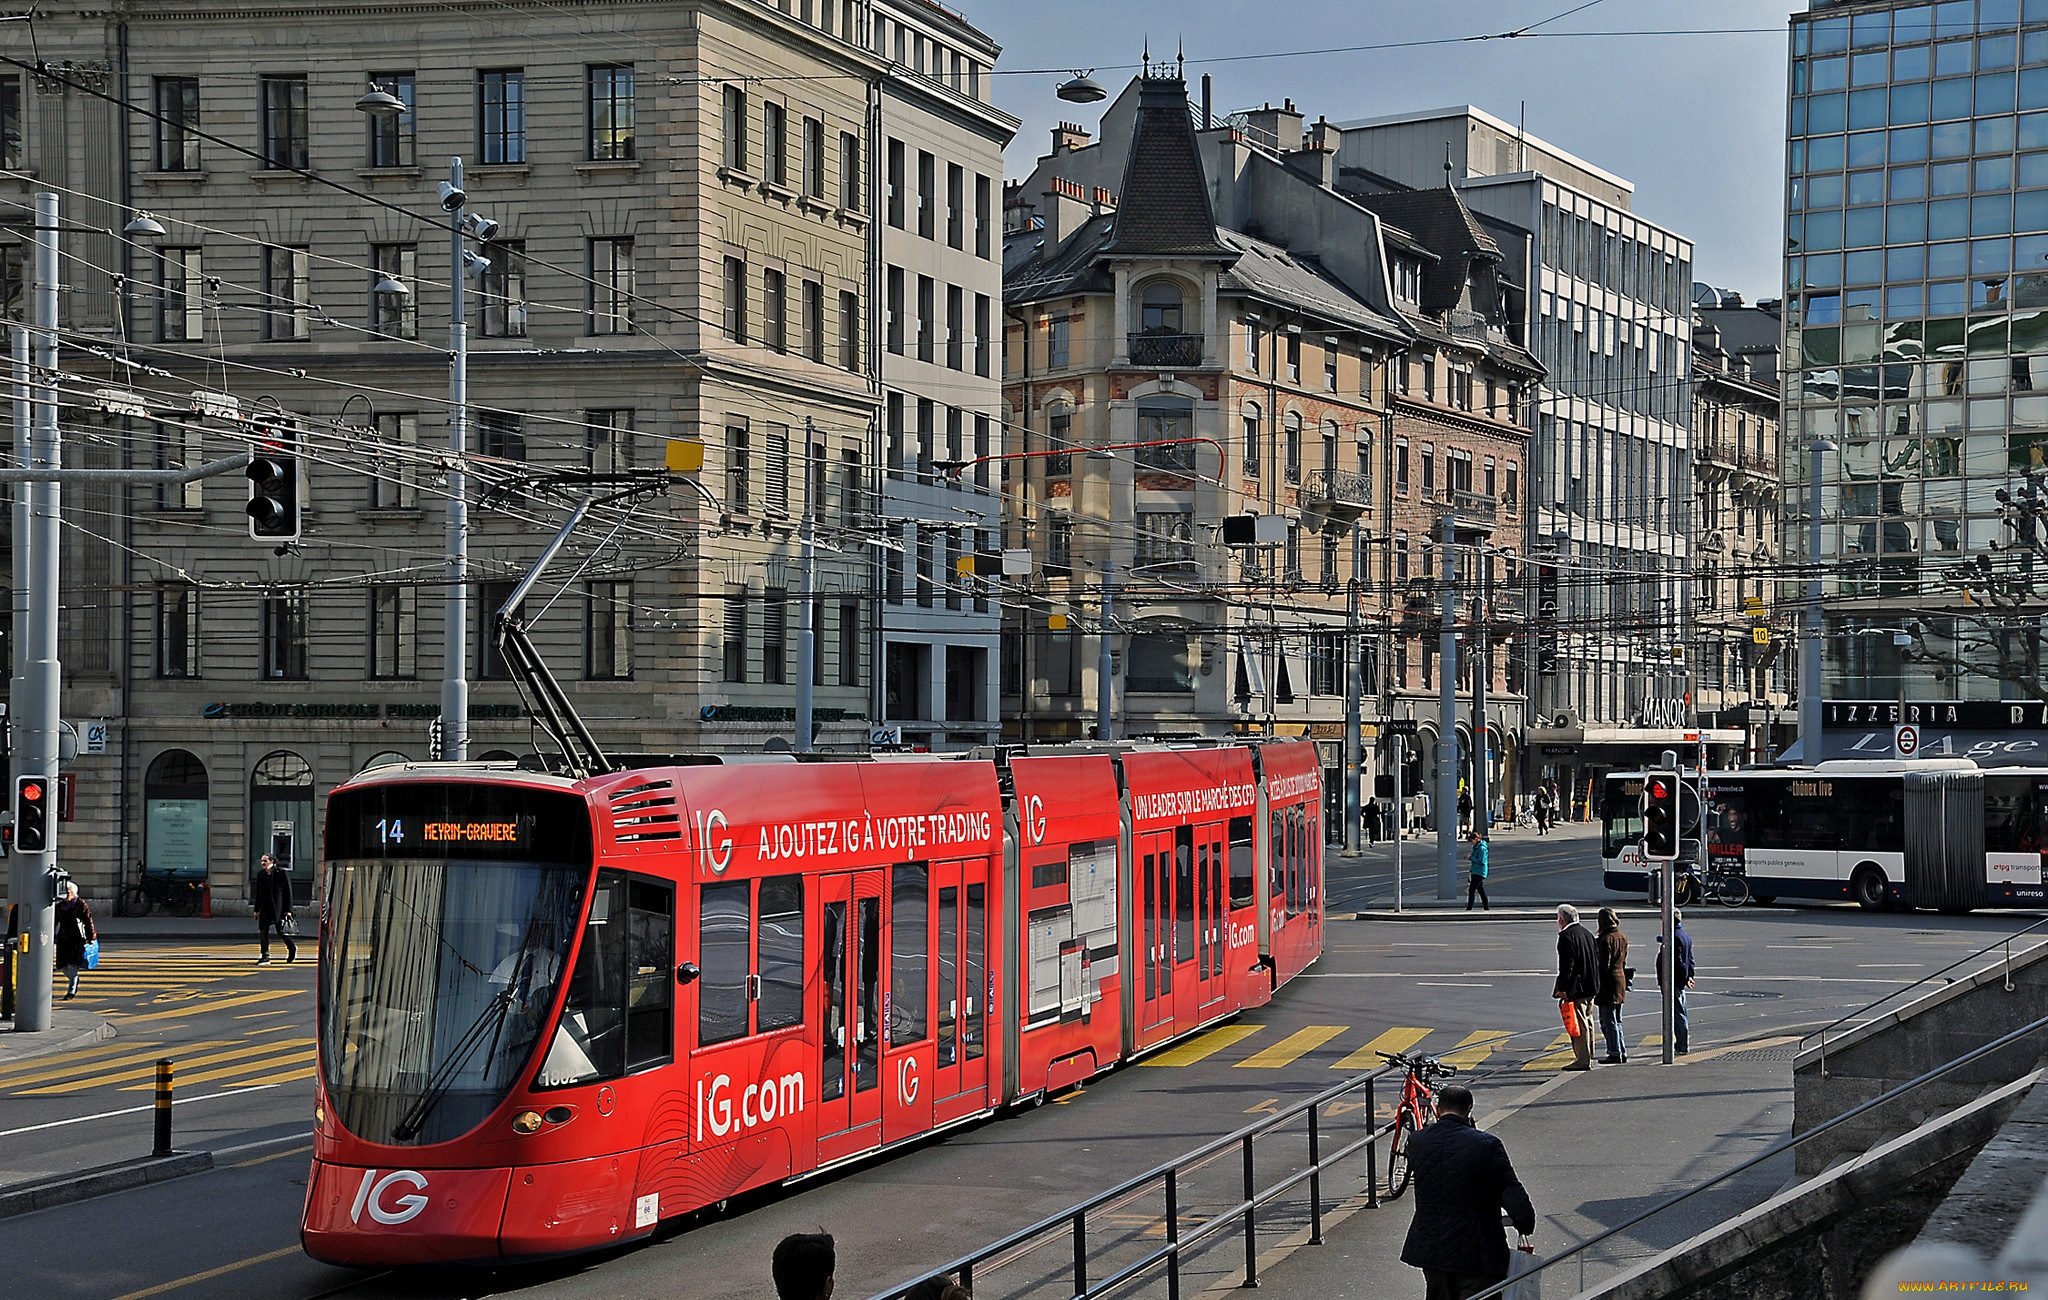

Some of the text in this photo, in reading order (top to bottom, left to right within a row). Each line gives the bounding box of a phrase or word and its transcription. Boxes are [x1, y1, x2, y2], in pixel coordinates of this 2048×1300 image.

[1755, 631, 1766, 641] 10
[230, 702, 293, 717] CRÉDIT
[294, 704, 380, 717] AGRICOLE
[385, 704, 520, 717] FINANENTS
[1643, 698, 1685, 727] MANOR
[1832, 705, 1958, 722] IZZERIA
[1134, 779, 1255, 820] UN LEADER SUR LE MARCHÉ DES CFD
[1819, 780, 1833, 796] live
[375, 818, 517, 844] 14 MEYRIN-GRAVIERE
[1024, 794, 1046, 846] IG
[695, 809, 733, 877] IG
[758, 809, 991, 861] AJOUTEZ IG À VOTRE TRADING
[1709, 844, 1743, 860] MILLER
[2016, 889, 2044, 898] unireso
[1229, 922, 1255, 950] IG.com
[898, 1056, 919, 1108] IG
[696, 1071, 805, 1142] IG.com
[350, 1168, 429, 1225] IG
